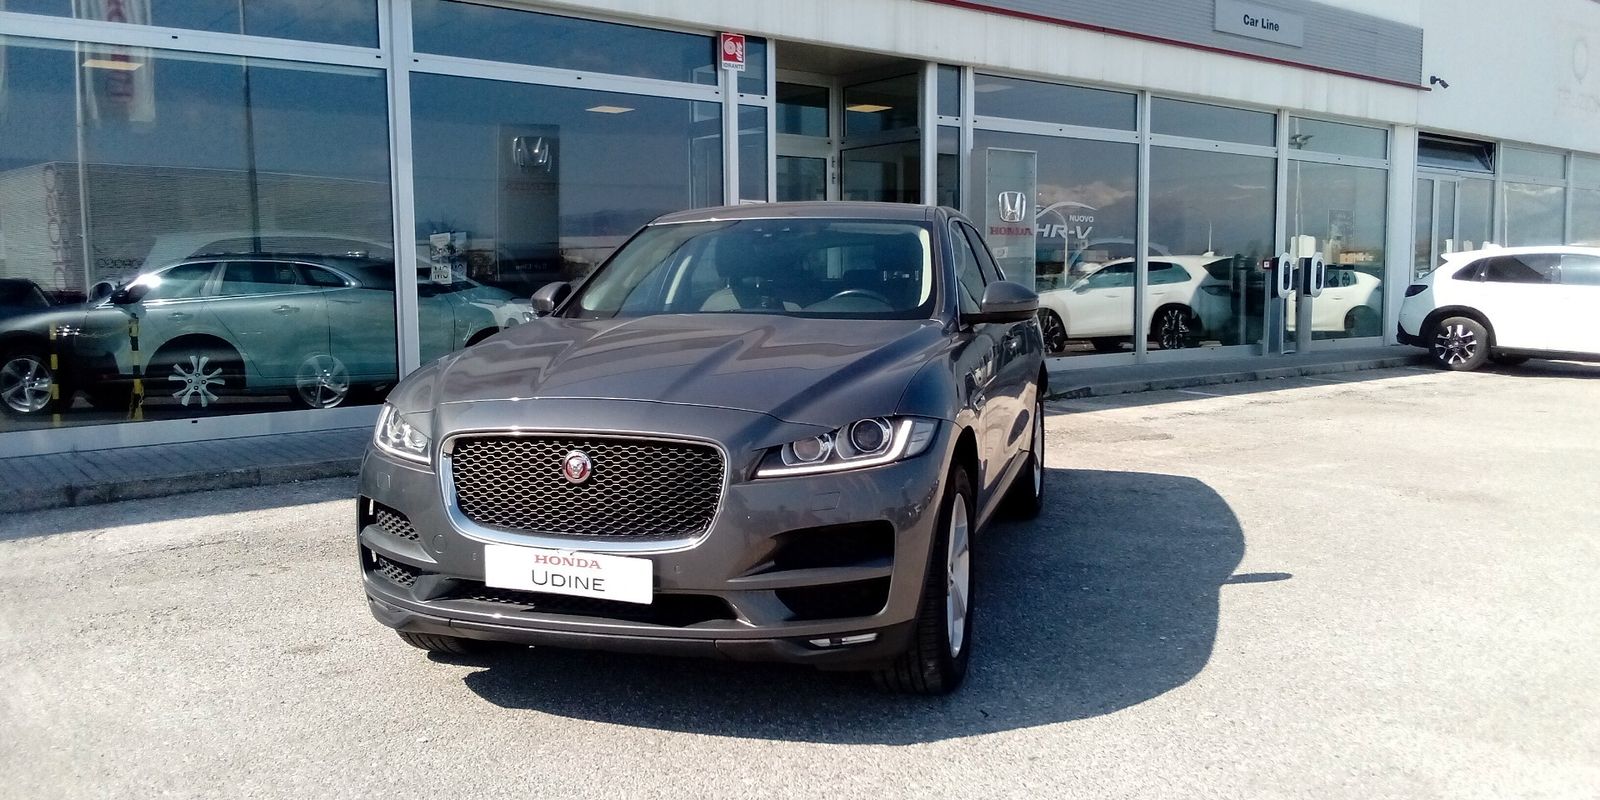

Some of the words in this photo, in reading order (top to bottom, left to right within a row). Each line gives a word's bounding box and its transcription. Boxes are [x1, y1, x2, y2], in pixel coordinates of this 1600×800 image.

[1243, 14, 1259, 28] Car
[1261, 17, 1280, 32] Line
[723, 62, 744, 70] IDRANTE
[1069, 214, 1095, 223] NUOVO
[989, 226, 1033, 236] HONDA
[534, 554, 603, 570] HONDA
[531, 569, 606, 592] UDINE
